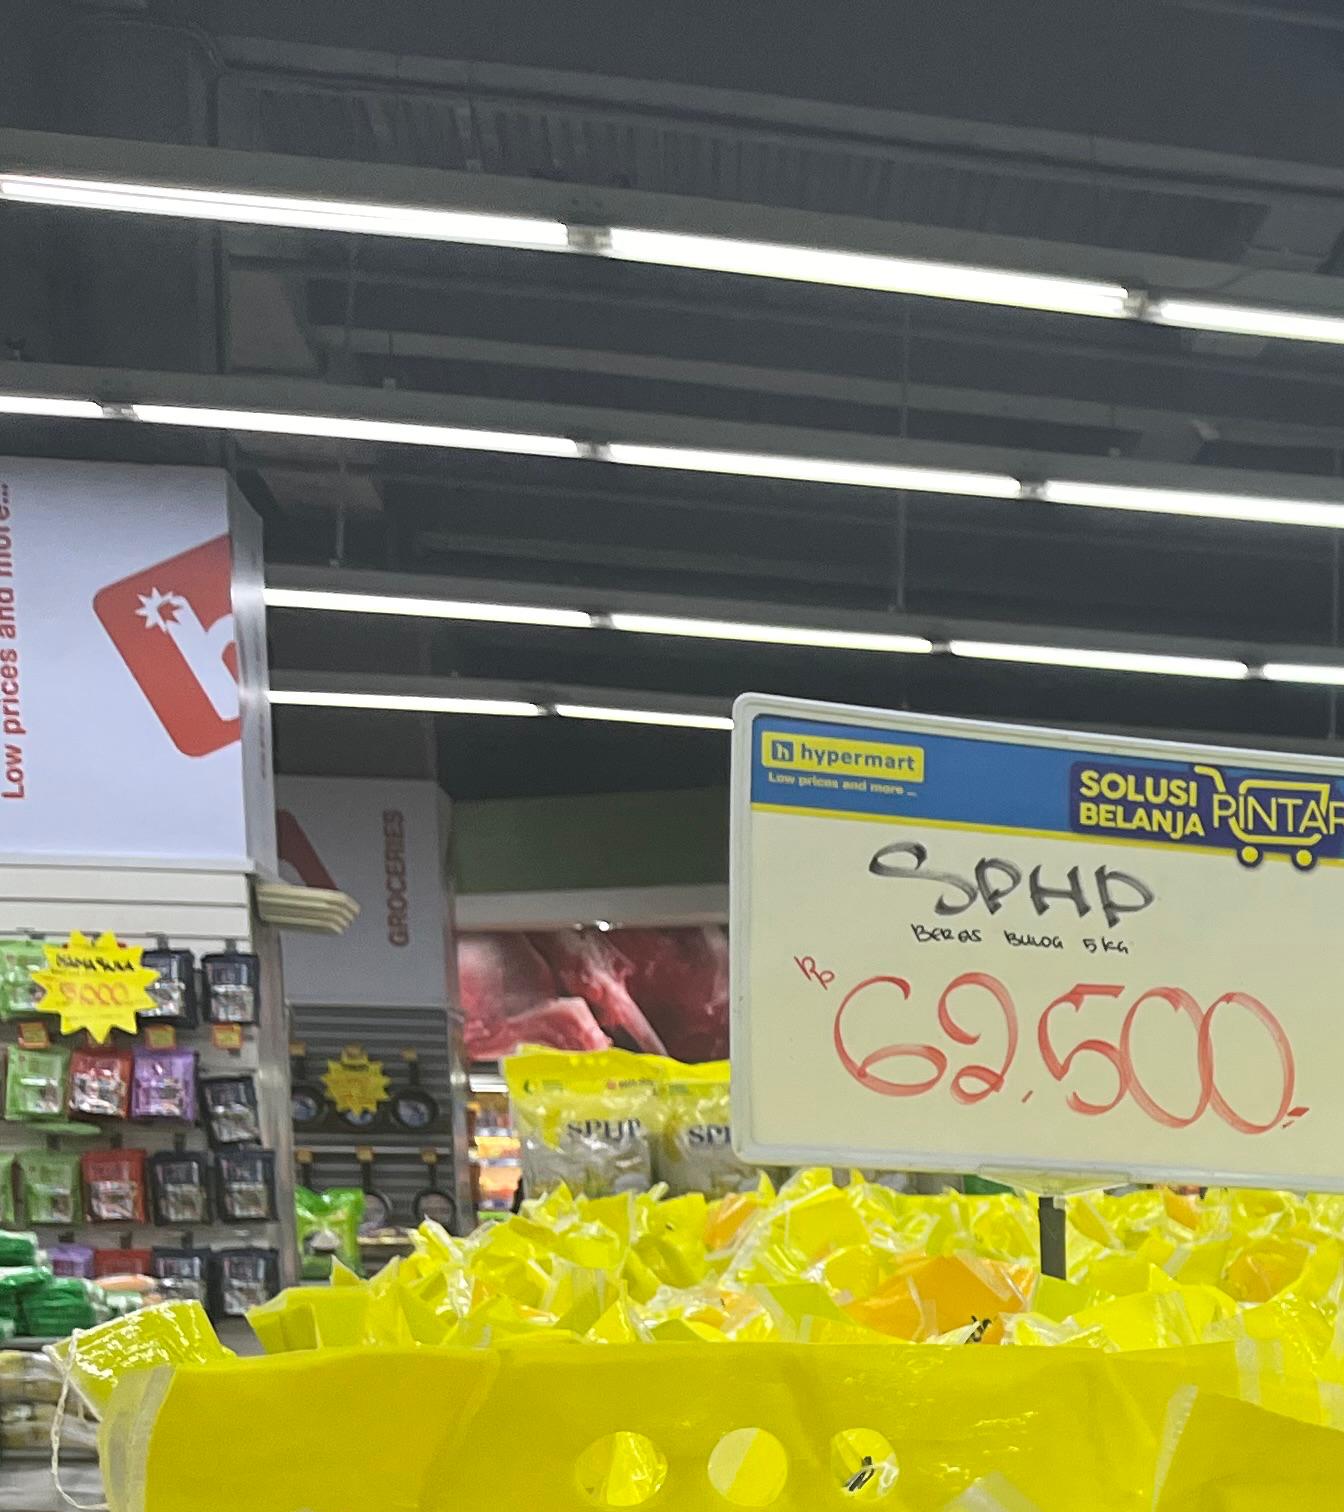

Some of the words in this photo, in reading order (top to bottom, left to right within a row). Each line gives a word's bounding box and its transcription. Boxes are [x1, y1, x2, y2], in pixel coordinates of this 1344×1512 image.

[1, 648, 27, 735] prices
[1, 743, 25, 800] Low
[800, 743, 916, 772] hypermart
[768, 771, 796, 785] Low
[843, 780, 867, 792] and
[1080, 769, 1198, 807] SOLUSI
[1079, 802, 1206, 840] BELANJA
[382, 810, 410, 946] GROCERIES
[868, 842, 1155, 928] SPHP
